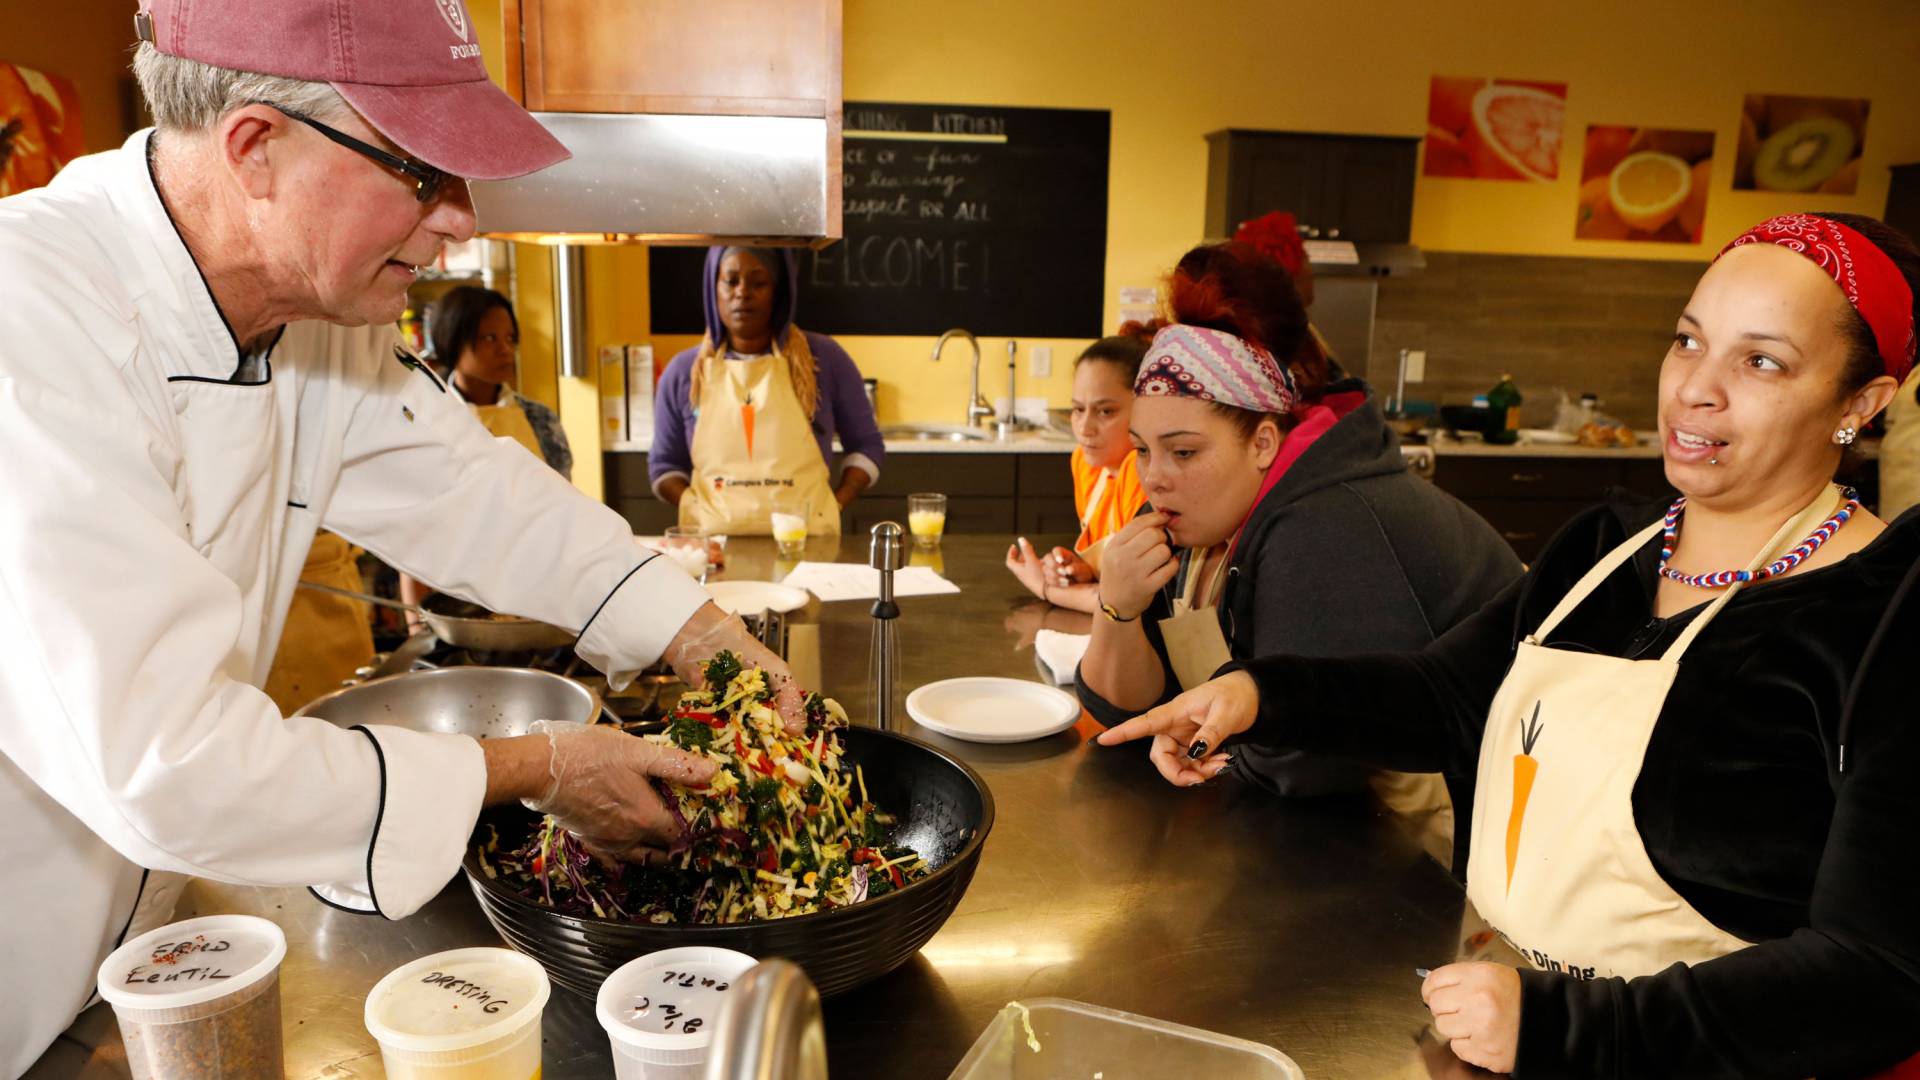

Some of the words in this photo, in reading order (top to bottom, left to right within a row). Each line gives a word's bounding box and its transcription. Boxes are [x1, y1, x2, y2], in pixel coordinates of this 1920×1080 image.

[842, 111, 907, 132] CHING
[932, 112, 1006, 135] KITCHEN
[843, 194, 909, 221] espect
[953, 201, 991, 221] ALL
[804, 235, 990, 293] ELCOME!
[1532, 949, 1596, 982] Dining
